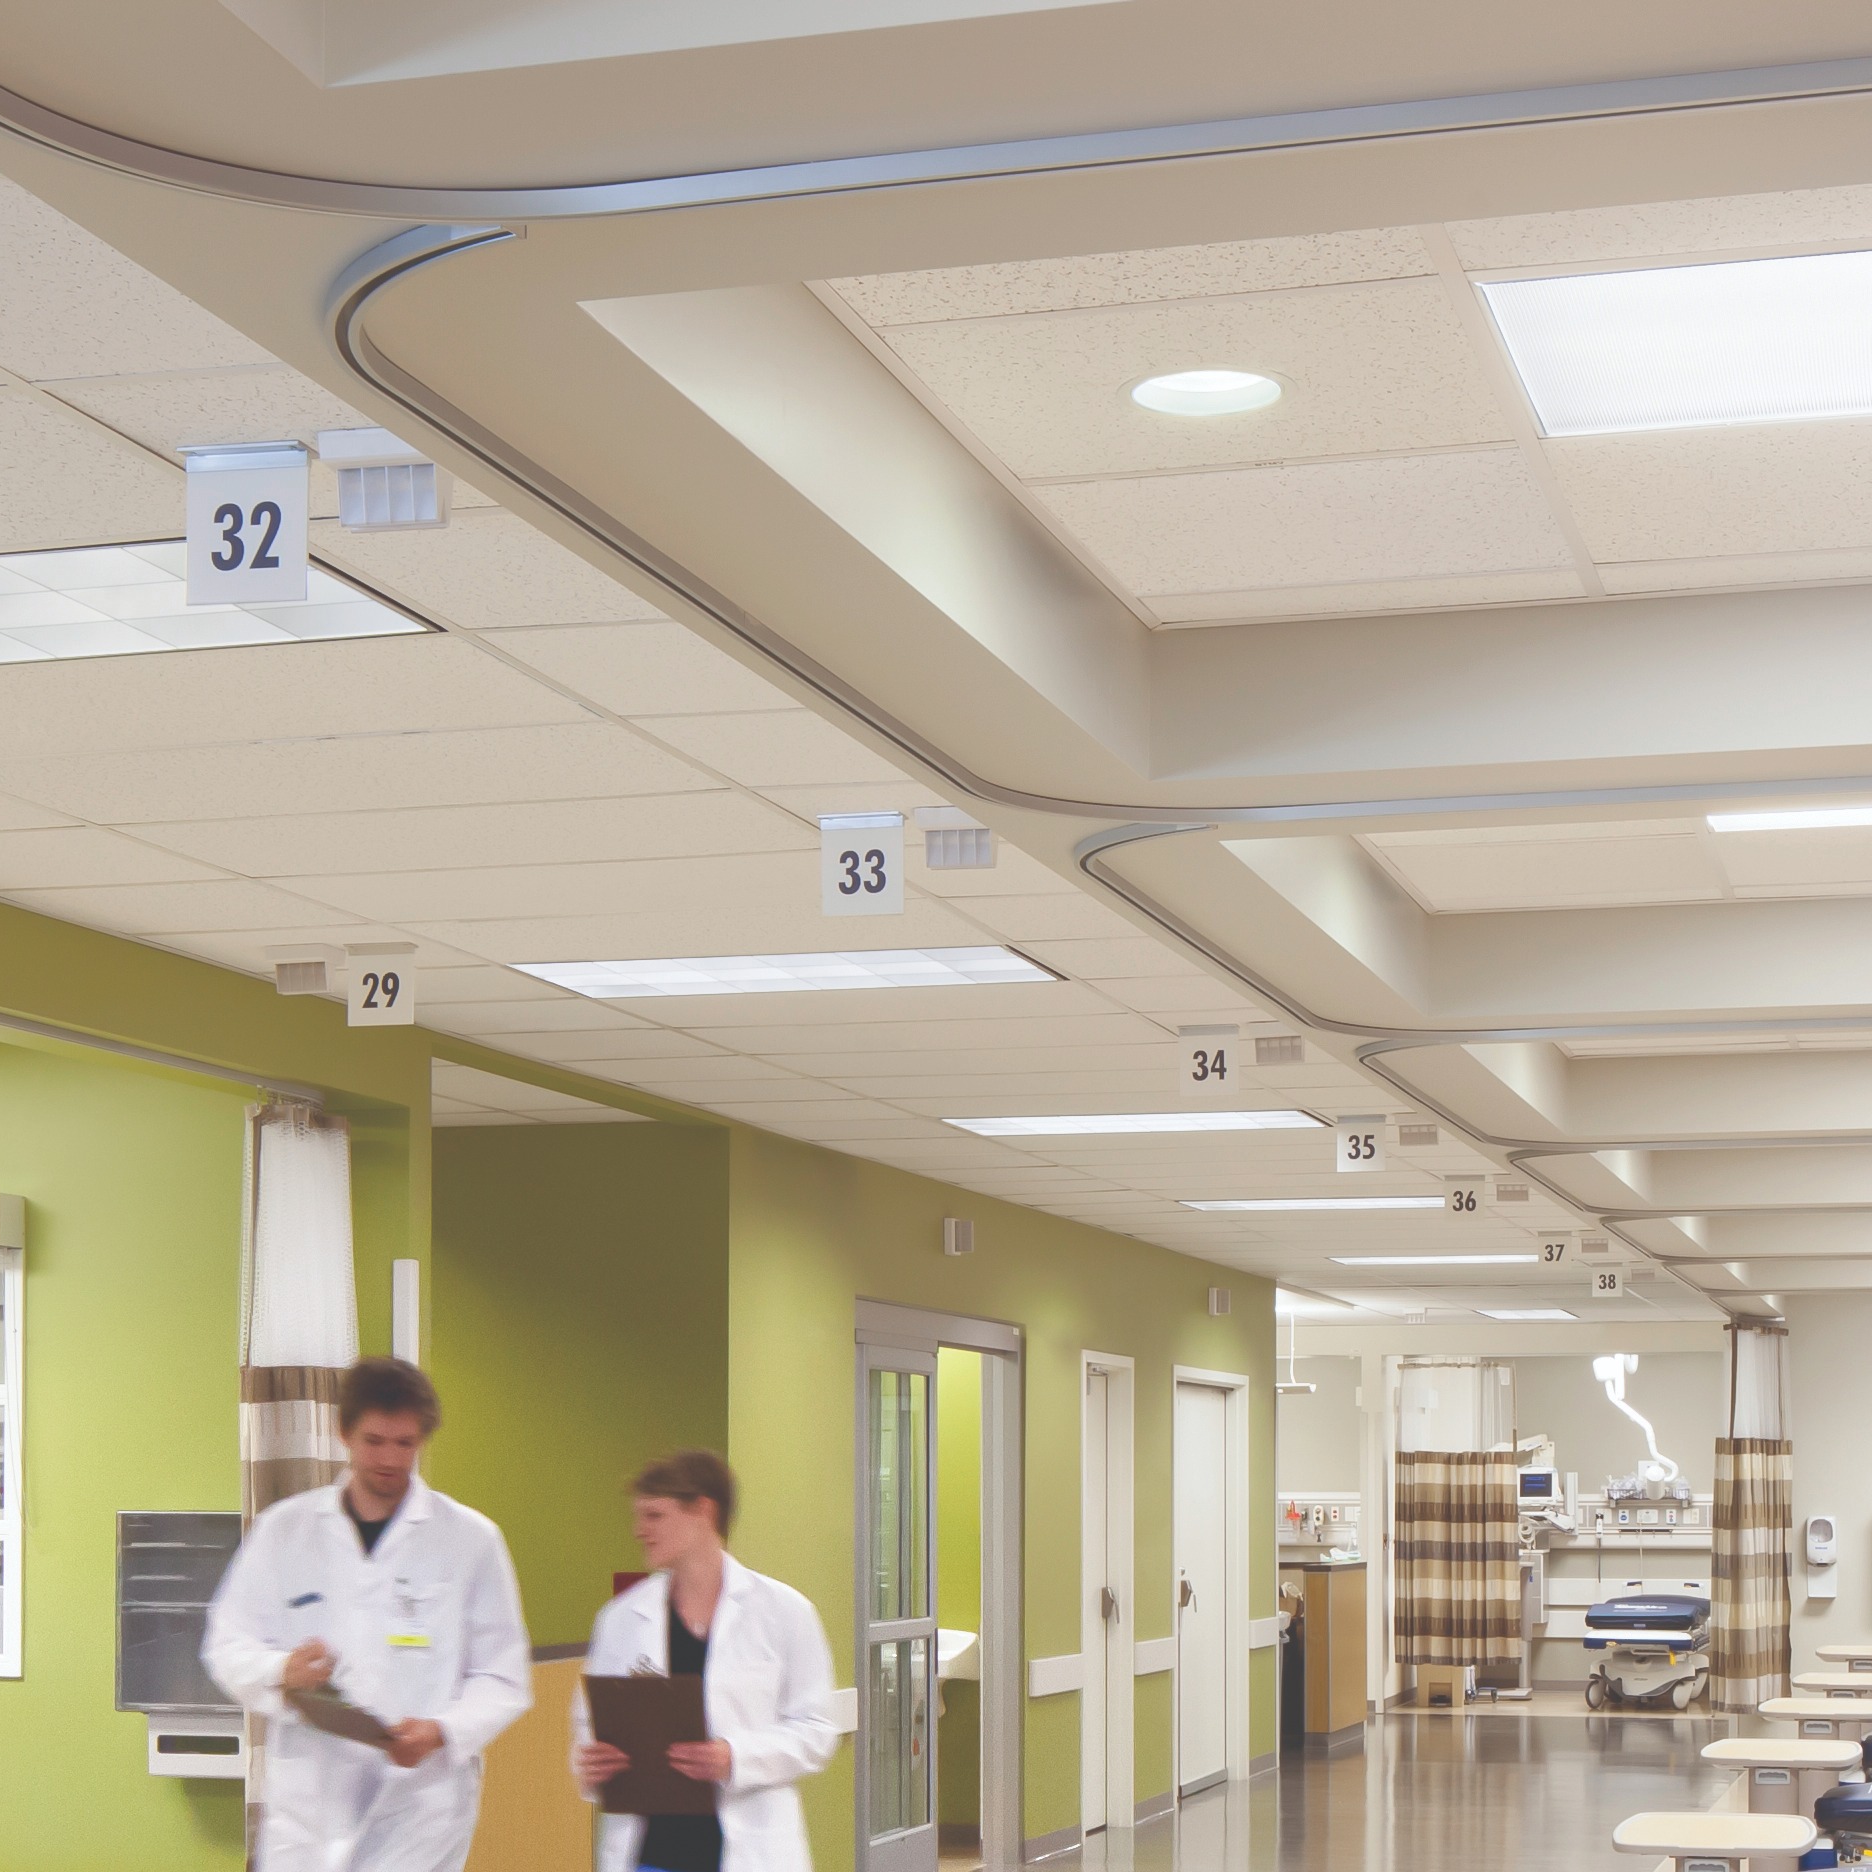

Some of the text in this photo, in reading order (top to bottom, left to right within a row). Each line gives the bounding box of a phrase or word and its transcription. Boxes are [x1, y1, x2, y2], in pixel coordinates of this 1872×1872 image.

[211, 501, 282, 572] 32
[838, 848, 887, 895] 33
[362, 971, 400, 1009] 29
[1192, 1049, 1227, 1082] 34
[1347, 1134, 1376, 1160] 35
[1452, 1190, 1477, 1212] 36
[1544, 1244, 1565, 1262] 37
[1598, 1274, 1617, 1290] 38
